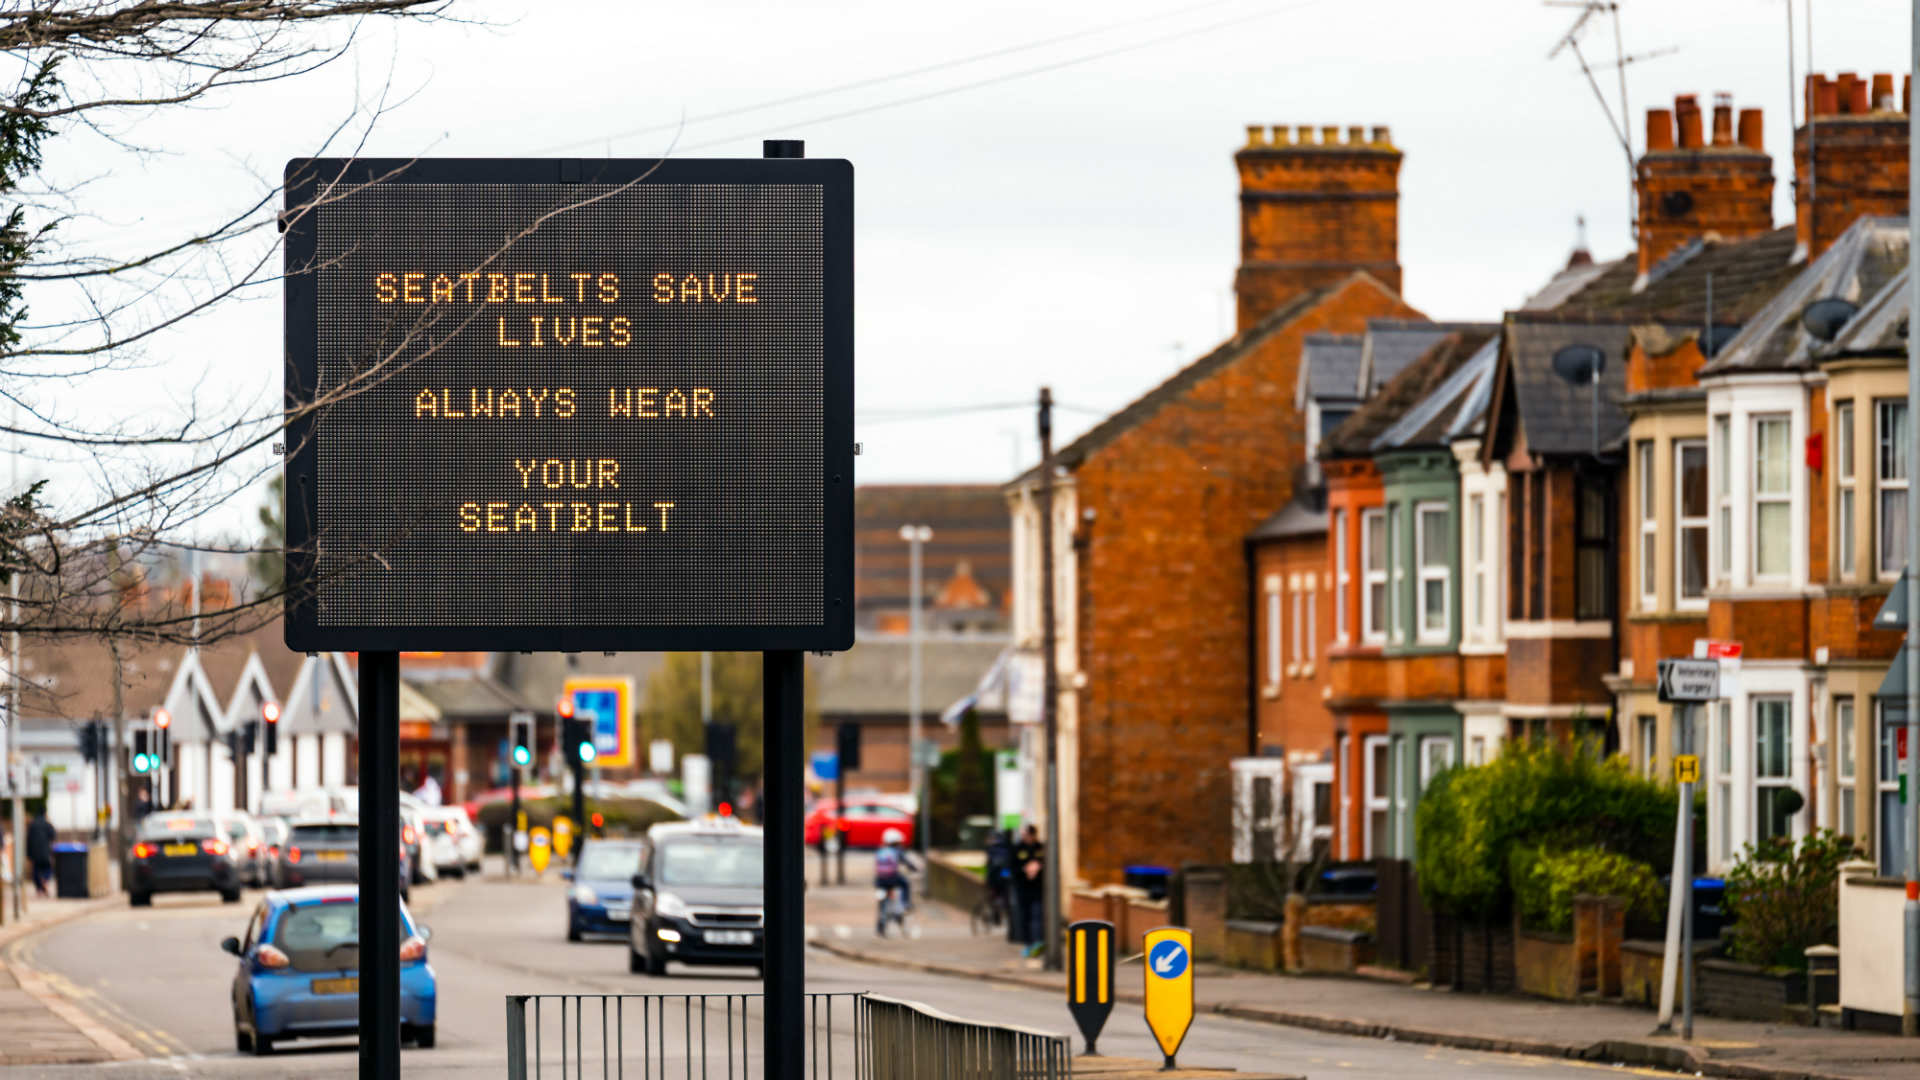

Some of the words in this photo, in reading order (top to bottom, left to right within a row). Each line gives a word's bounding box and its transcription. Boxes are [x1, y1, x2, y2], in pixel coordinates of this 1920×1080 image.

[376, 271, 620, 304] SEATBELTS
[652, 272, 760, 304] SAVE
[498, 316, 632, 347] LIVES
[415, 387, 577, 418] ALWAYS
[609, 387, 715, 419] WEAR
[515, 458, 620, 490] YOUR
[459, 502, 675, 533] SEATBELT
[1679, 760, 1696, 778] H
